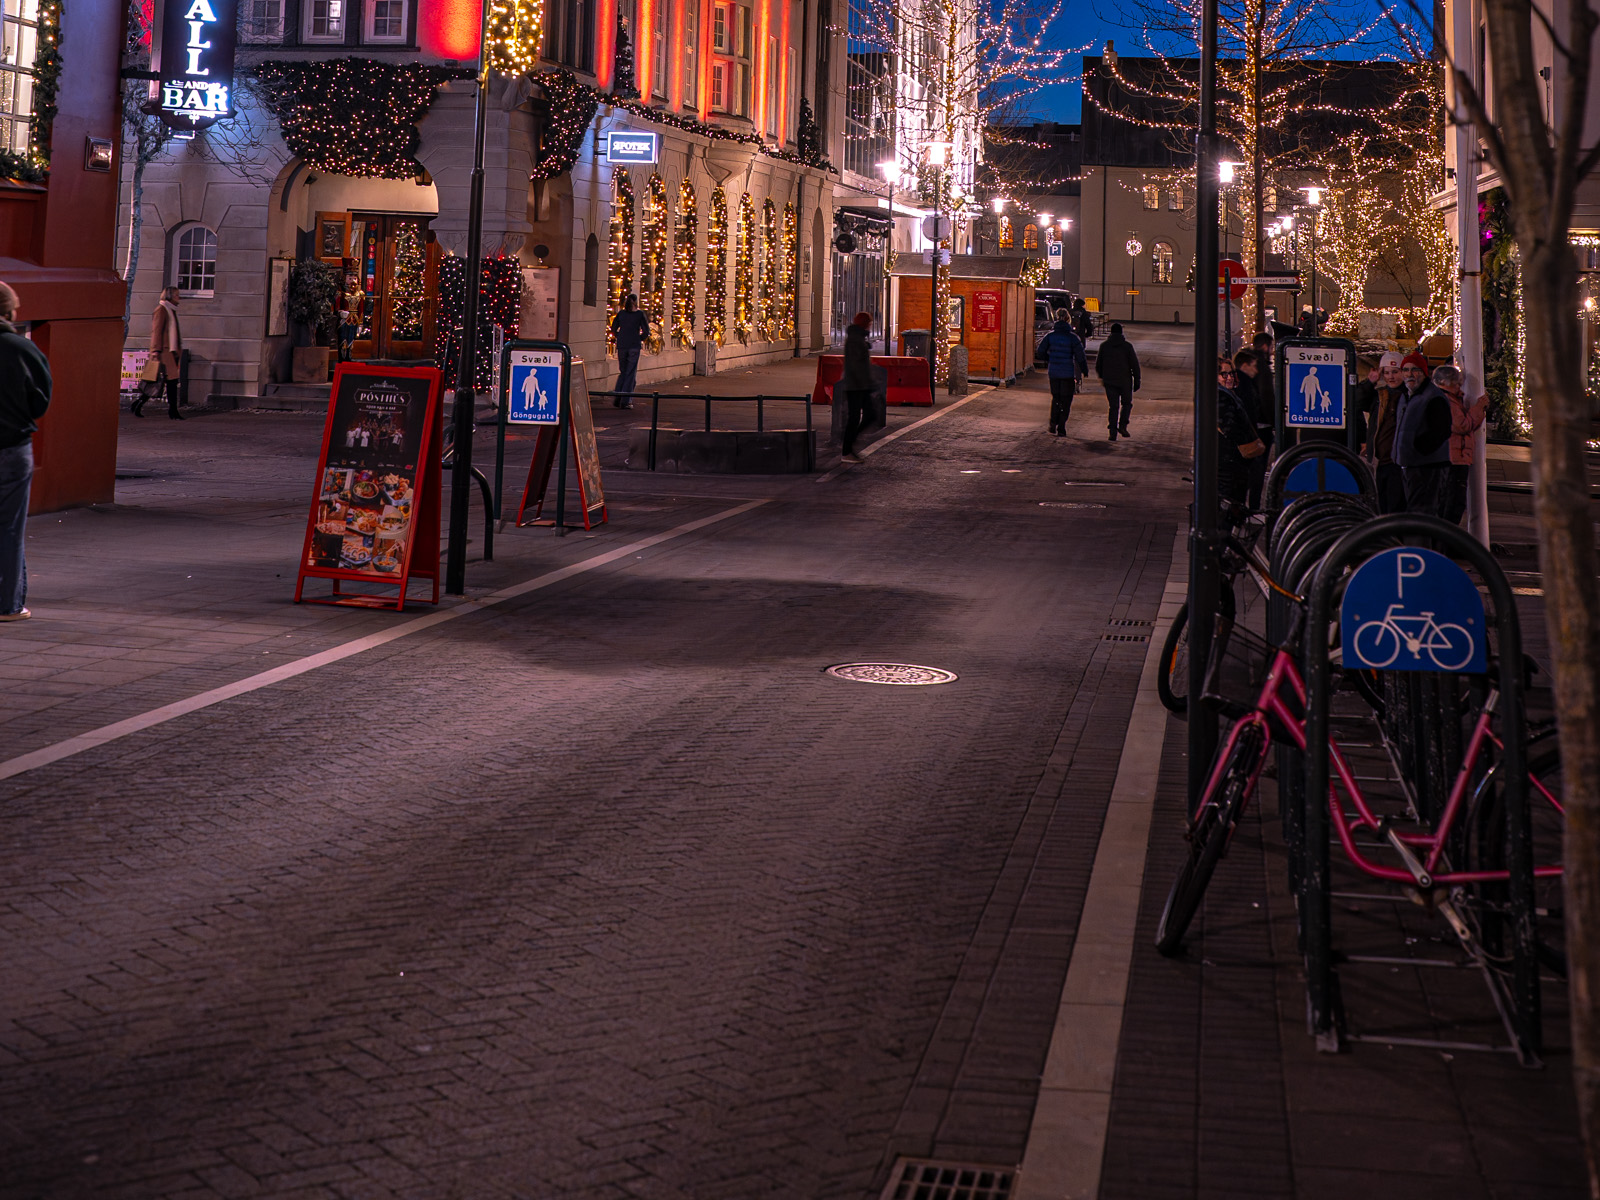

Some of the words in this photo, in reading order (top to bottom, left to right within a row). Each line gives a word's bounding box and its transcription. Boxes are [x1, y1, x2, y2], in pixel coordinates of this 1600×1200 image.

[184, 80, 209, 90] AND
[162, 87, 229, 111] BAR
[521, 355, 552, 364] Svæði
[1299, 352, 1334, 362] Svæði
[512, 412, 555, 420] Göngugata
[1291, 414, 1340, 423] Göngugata
[1397, 553, 1425, 599] P
